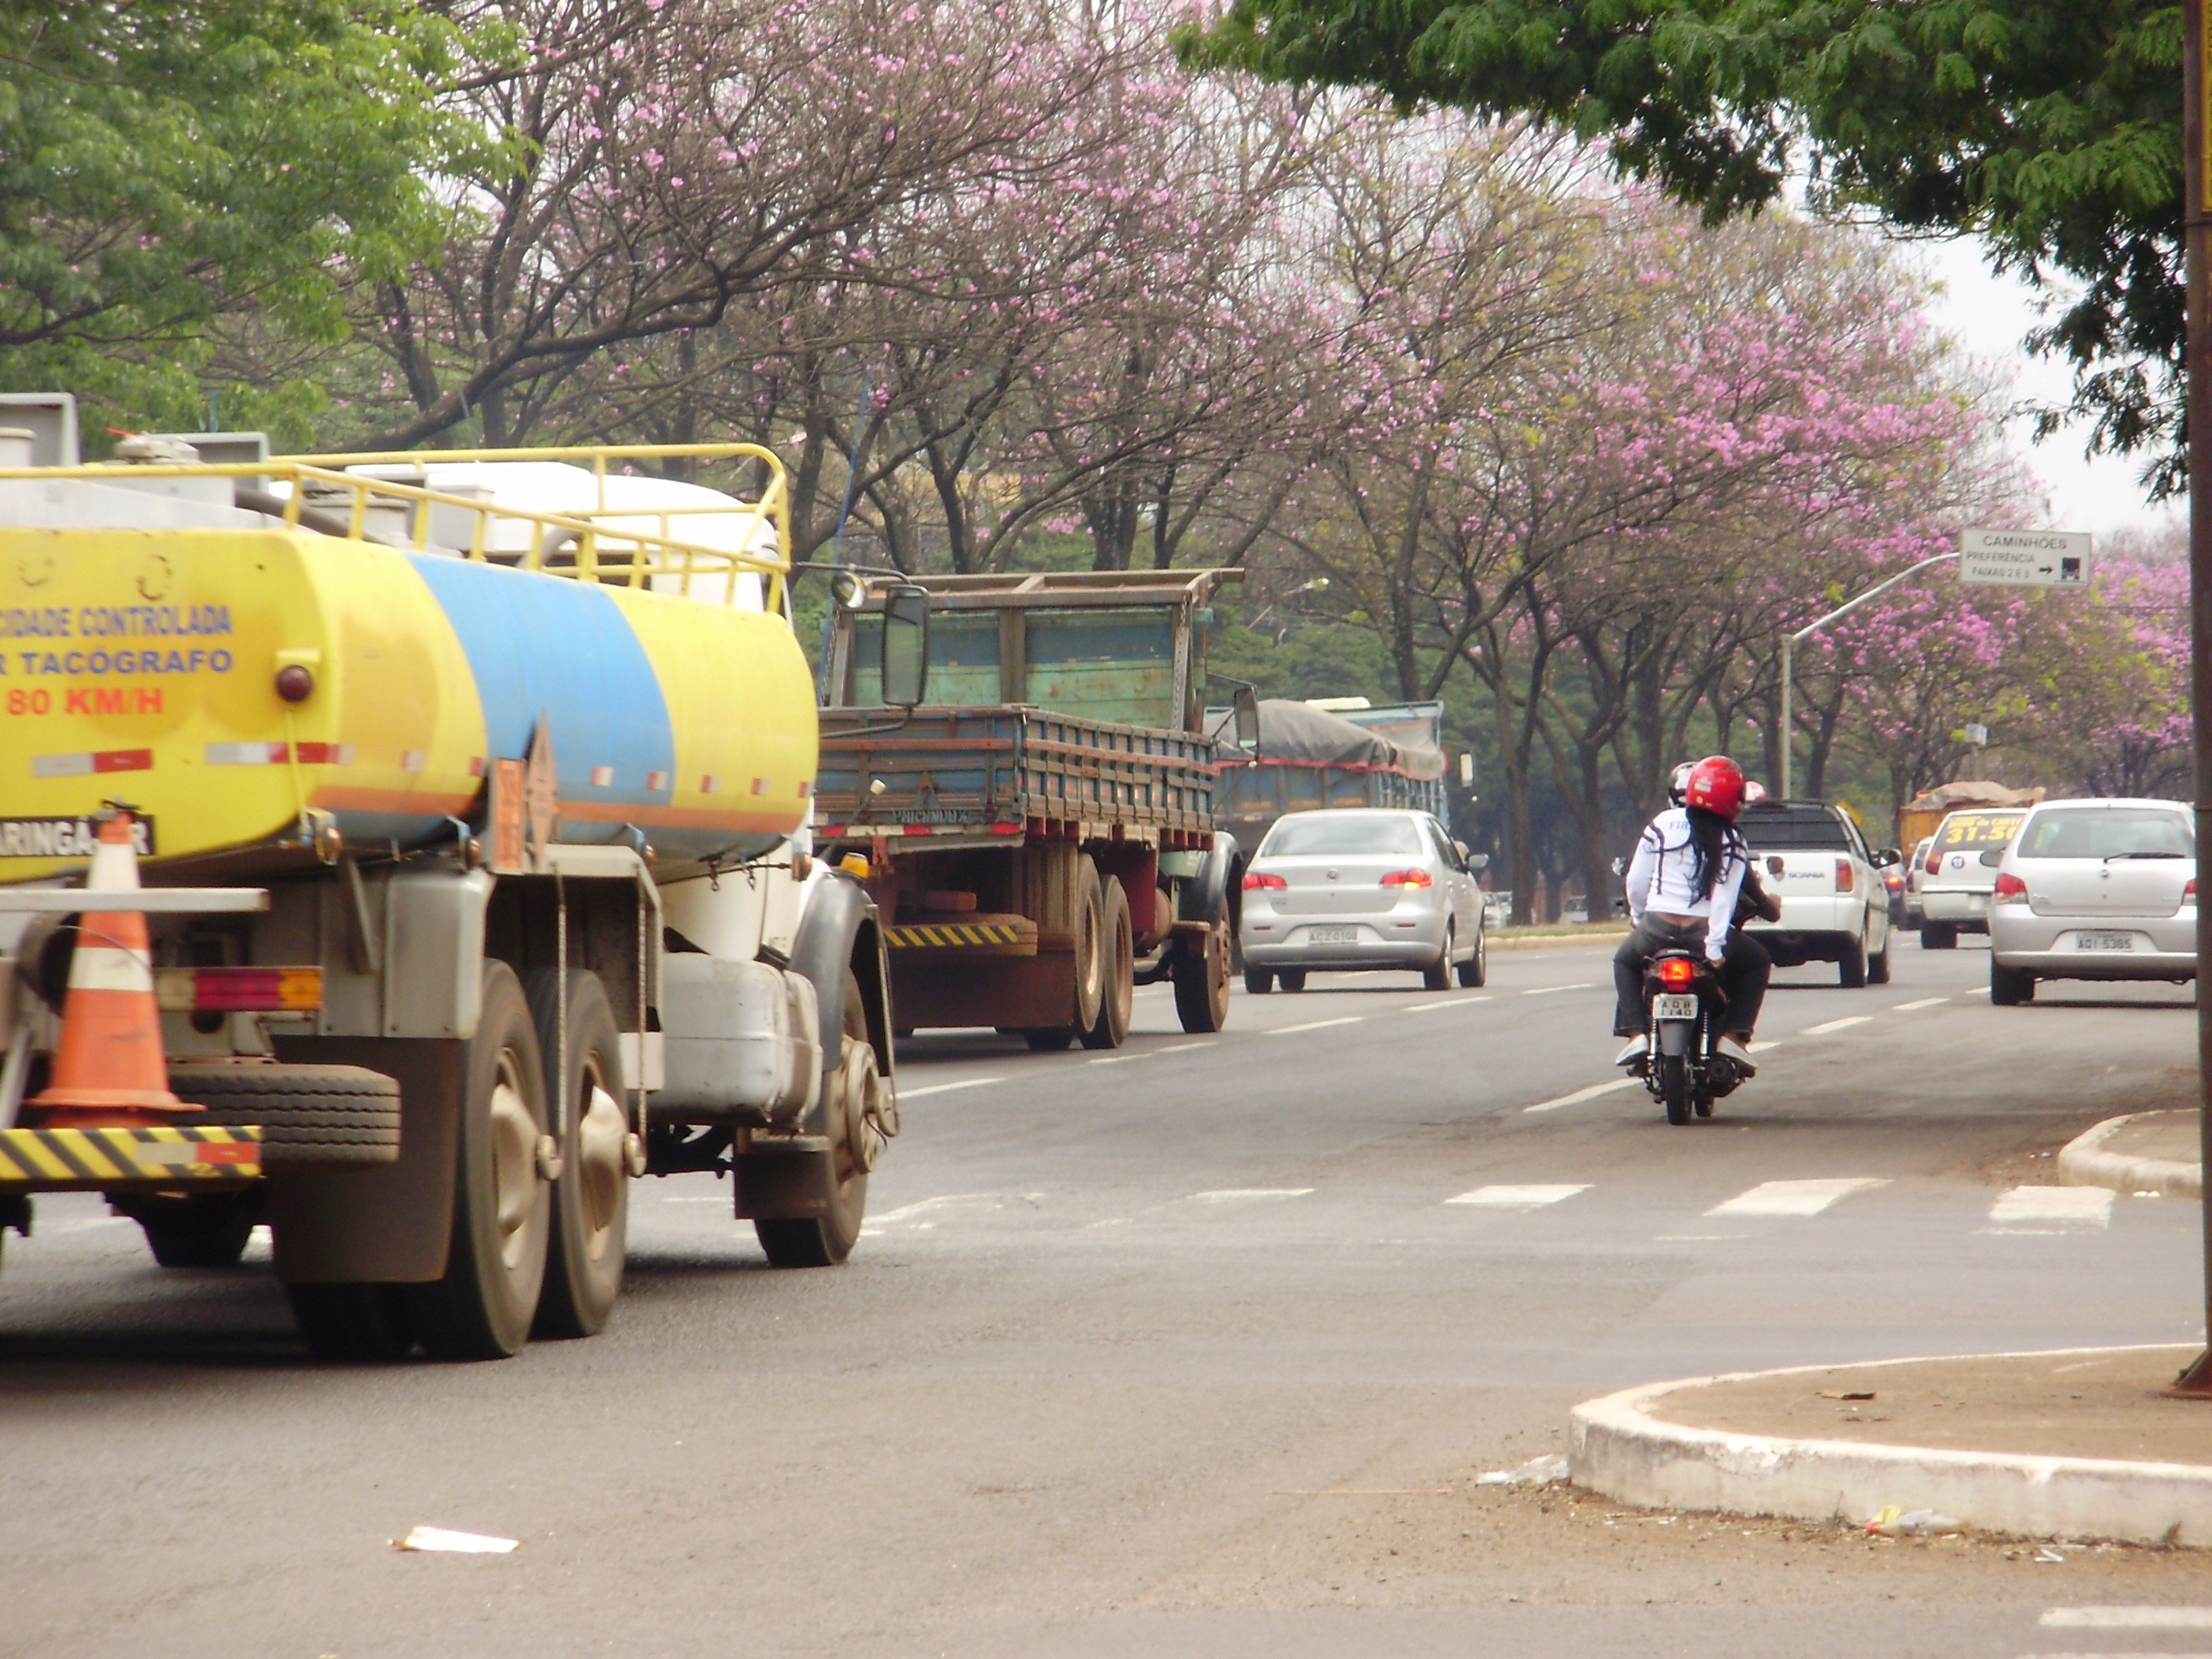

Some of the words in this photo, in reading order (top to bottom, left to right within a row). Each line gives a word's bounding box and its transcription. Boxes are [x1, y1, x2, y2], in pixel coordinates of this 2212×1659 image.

[79, 605, 232, 637] CONTROLADA
[7, 688, 52, 716] 80
[65, 687, 164, 715] KM/H
